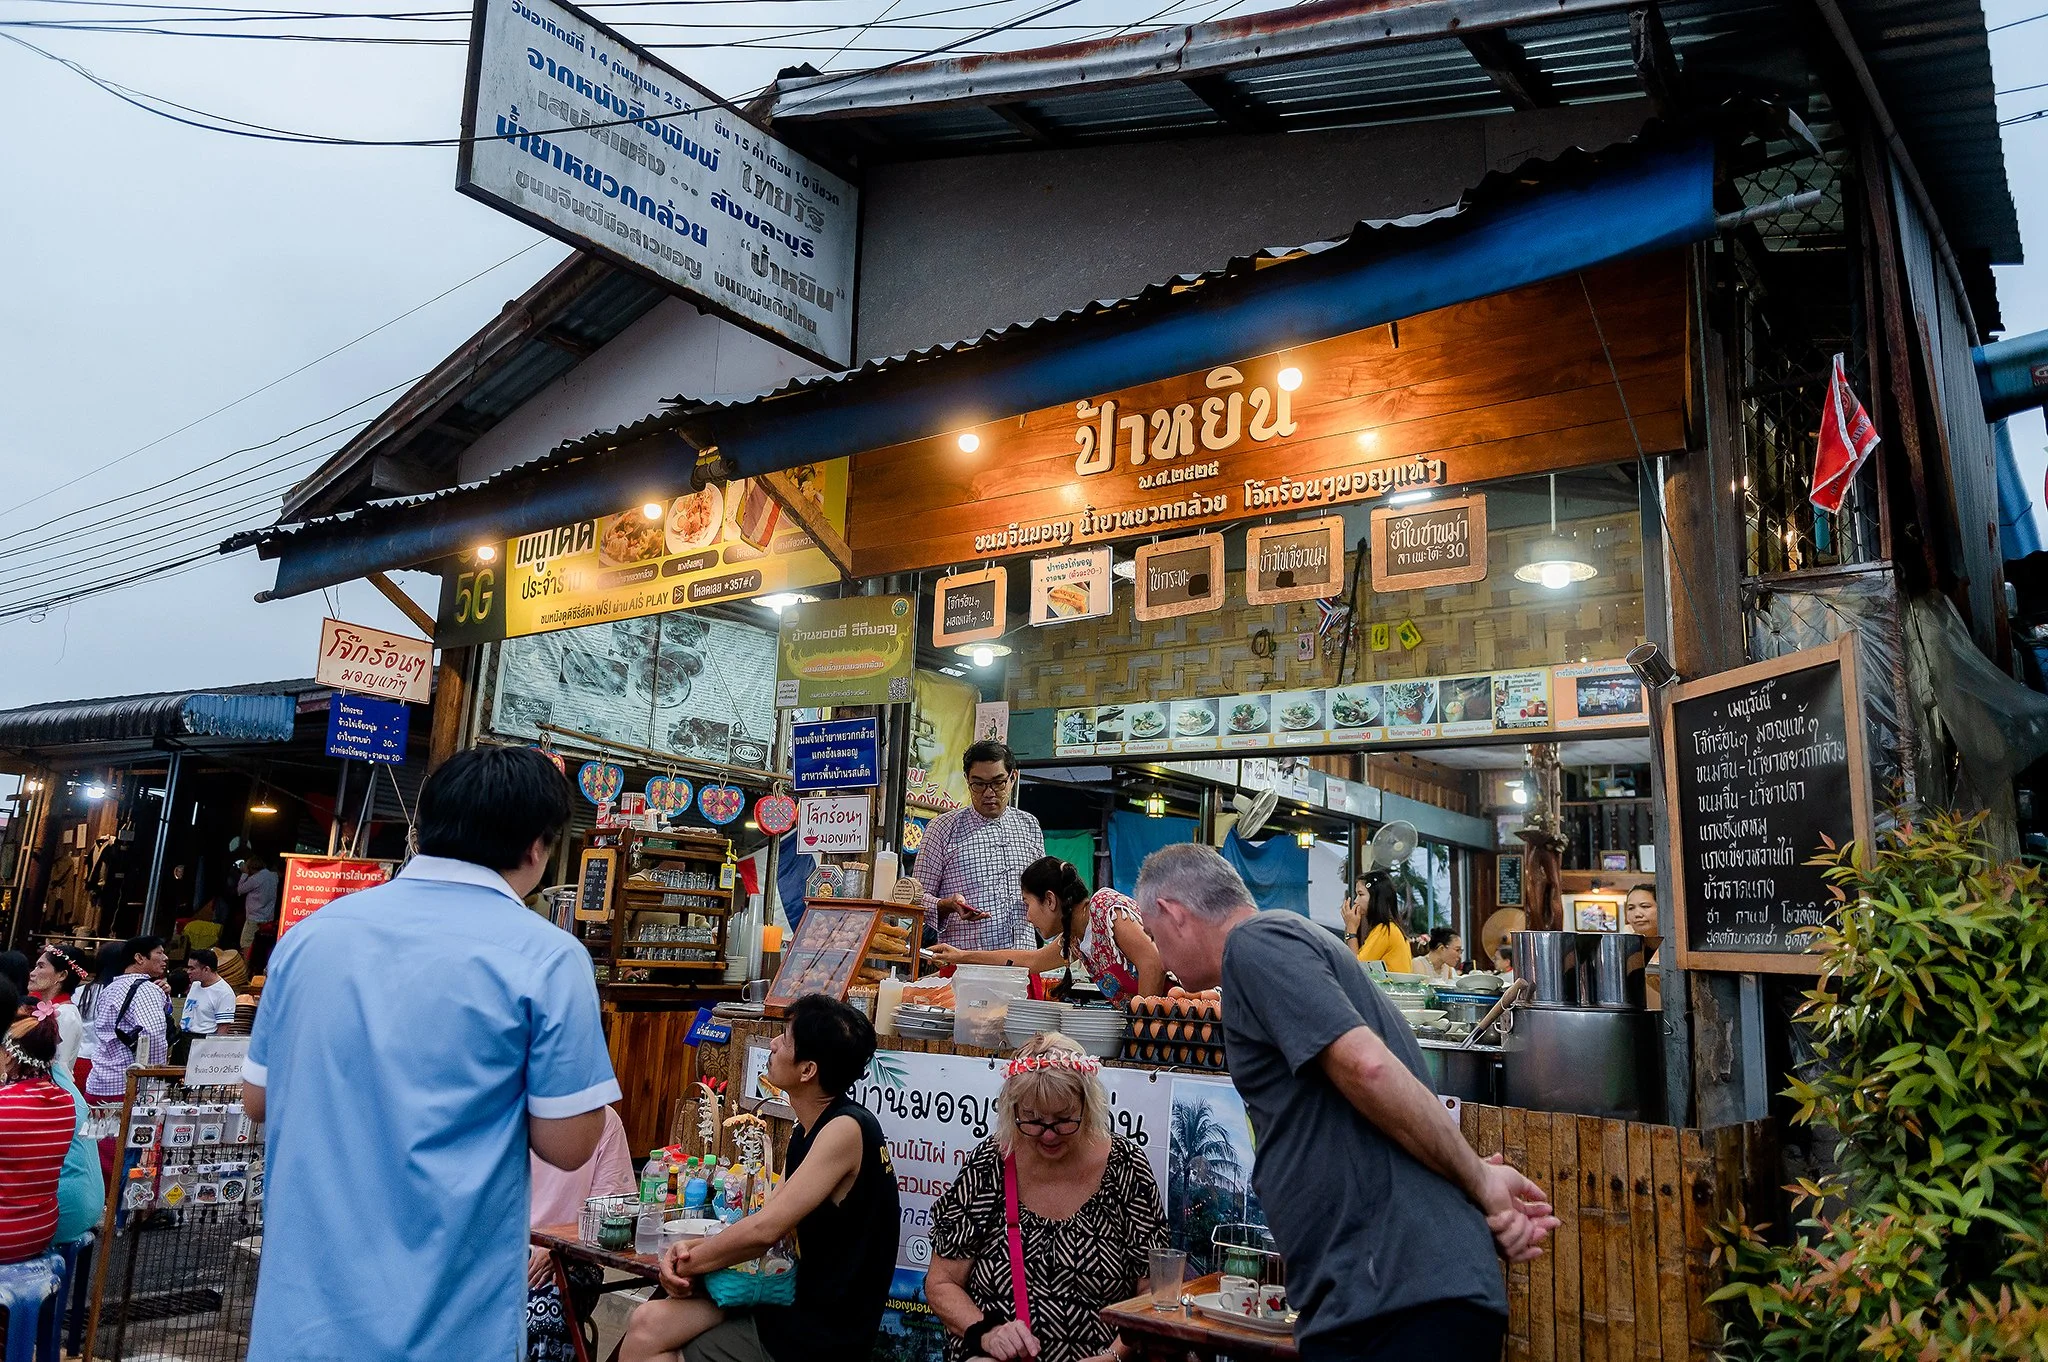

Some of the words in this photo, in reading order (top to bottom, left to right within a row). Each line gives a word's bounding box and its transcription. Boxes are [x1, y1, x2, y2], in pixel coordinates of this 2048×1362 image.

[511, 0, 585, 53] วันอาทิตย์ที่
[590, 46, 608, 67] 14
[611, 59, 660, 98] กันยายน
[734, 132, 750, 151] 15
[766, 154, 791, 178] เดือน
[795, 170, 809, 188] 10
[527, 47, 721, 173] จากหนังสือพิมพ์
[741, 161, 825, 235] ไทยรัฐ
[496, 104, 708, 248] น้ำยาหยวกกล้วย
[710, 189, 814, 259] สังขละบุรี
[714, 265, 817, 335] บนแผ่นดินไทย
[1074, 366, 1298, 476] ป้าหยิน
[1138, 460, 1220, 490] พ.ศ.๒๕๒๕
[974, 518, 1073, 552] ขนมจีนมอญ
[1078, 492, 1228, 535] น้ำยาหยวกกล้วย
[1390, 513, 1468, 550] ยำใบชาพม่า
[693, 583, 722, 599] โหลดเลย
[1149, 567, 1190, 591] ไข่กระทะ
[455, 568, 495, 626] 5G
[646, 592, 669, 607] PLAY
[792, 624, 847, 642] บ้านของดี
[326, 628, 426, 682] โจ๊กร้อนๆ
[341, 669, 408, 695] มอญแท้ๆ
[1728, 680, 1776, 723] เมนูวันนี้
[795, 727, 875, 745] ขนมจีนน้ำยาหยวกกล้วย
[1693, 722, 1748, 756] โจ๊กร้อนๆ
[811, 746, 858, 760] แกงฮังเลมอญ
[801, 764, 871, 782] อาหารพื้นบ้านรสเด็ด
[807, 802, 862, 826] โจ๊กร้อนๆ
[820, 829, 862, 846] มอญแท้ๆ
[1700, 836, 1794, 871] แกงเขียวหวานไก่
[1704, 874, 1775, 901] ข้าวราดแกง
[1706, 907, 1720, 924] ชา
[1735, 904, 1769, 924] กาแฟ
